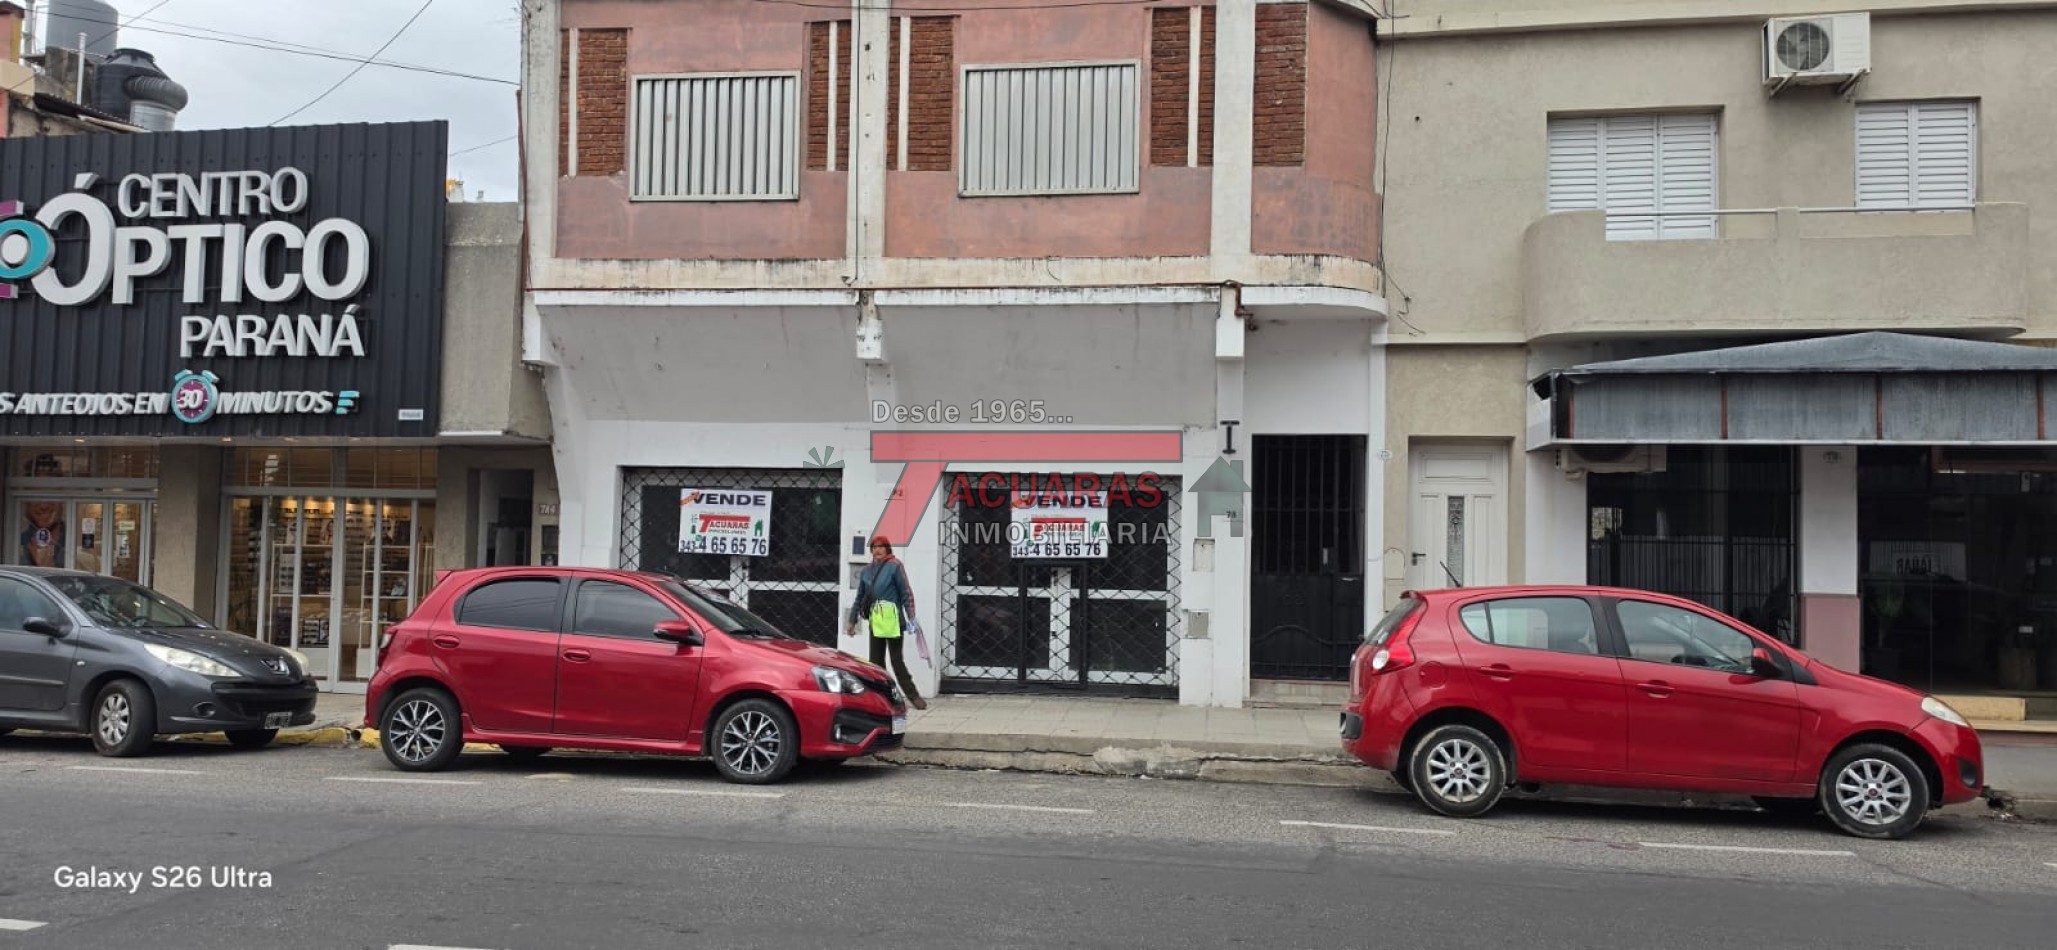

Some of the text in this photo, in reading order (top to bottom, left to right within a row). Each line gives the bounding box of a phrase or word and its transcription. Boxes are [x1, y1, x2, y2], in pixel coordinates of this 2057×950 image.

[118, 167, 308, 219] CENTRO
[31, 172, 369, 305] ÓPTICO
[180, 304, 364, 358] PARANÁ
[14, 392, 134, 414] ANTEOJOS
[133, 392, 171, 414] EN
[179, 389, 203, 409] 30
[216, 390, 334, 414] MINUTOS
[690, 492, 766, 506] VENDE
[711, 536, 727, 553] 65
[731, 537, 747, 554] 65
[751, 538, 767, 555] 76
[1045, 543, 1060, 556] 65
[1065, 543, 1081, 556] 65
[1085, 543, 1101, 556] 76
